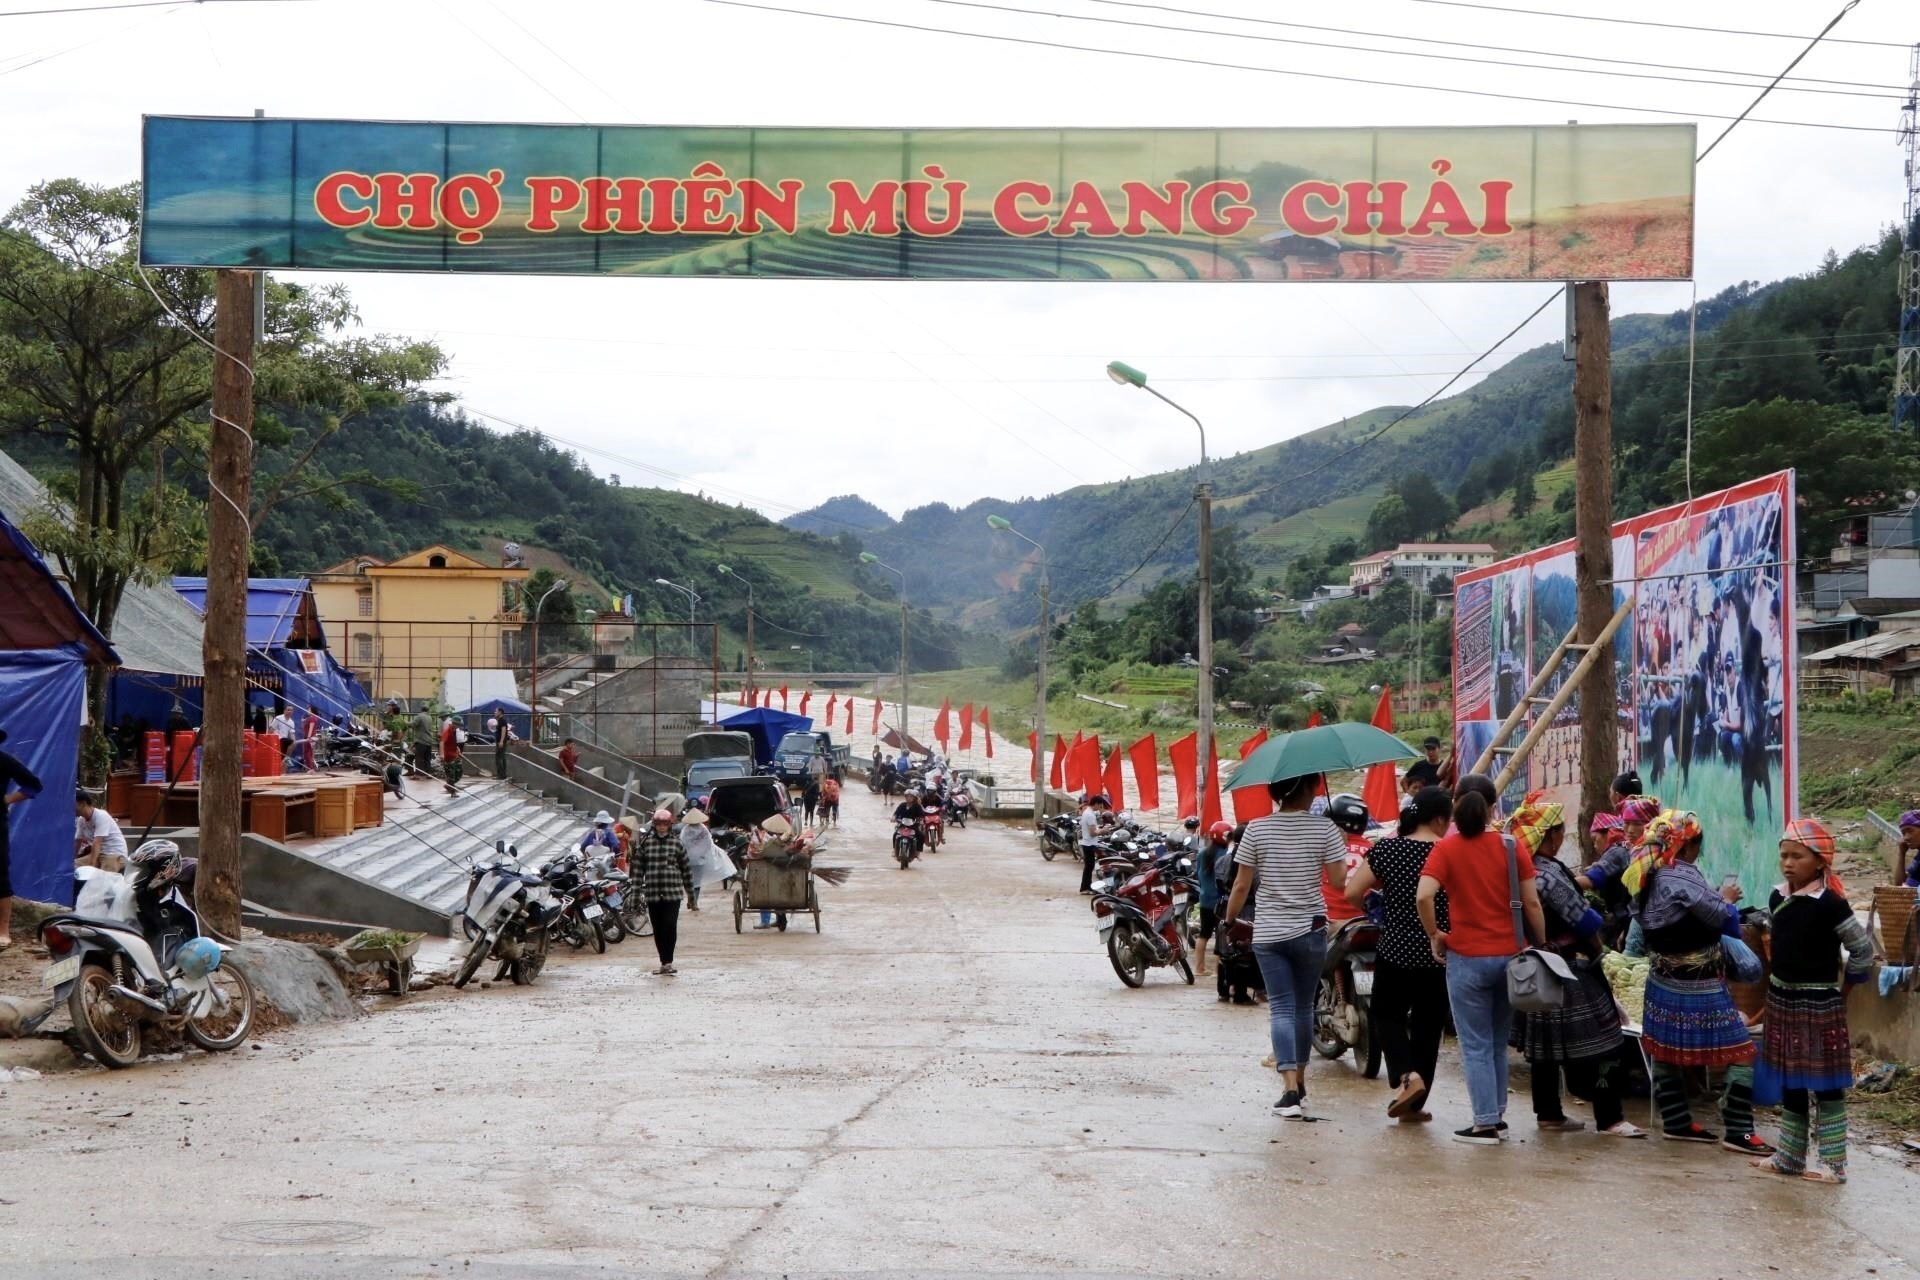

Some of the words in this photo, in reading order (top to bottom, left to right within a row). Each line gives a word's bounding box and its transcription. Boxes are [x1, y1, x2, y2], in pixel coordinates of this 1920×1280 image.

[315, 170, 504, 244] CHỢ
[525, 160, 803, 236] PHIÊN
[827, 165, 967, 237] MÙ
[993, 180, 1257, 237] CANG
[1281, 159, 1514, 237] CHẢI
